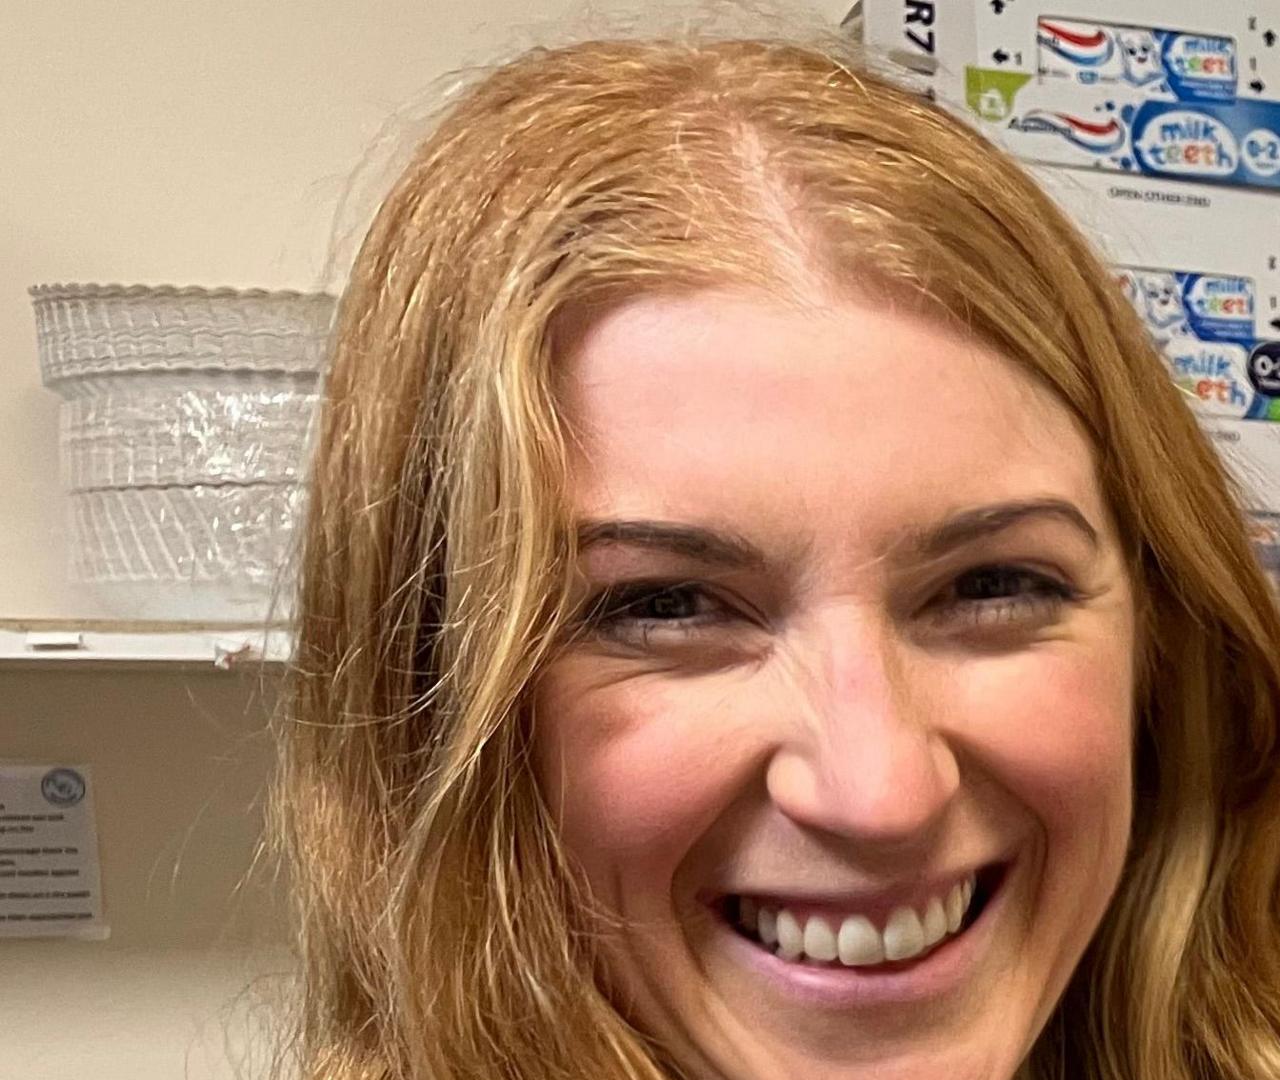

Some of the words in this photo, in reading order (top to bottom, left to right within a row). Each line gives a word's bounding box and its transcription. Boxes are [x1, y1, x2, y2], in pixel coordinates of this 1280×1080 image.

[1160, 116, 1220, 143] milk
[1147, 143, 1234, 169] teeth
[1246, 139, 1279, 160] 0-2
[1173, 350, 1231, 376] milk
